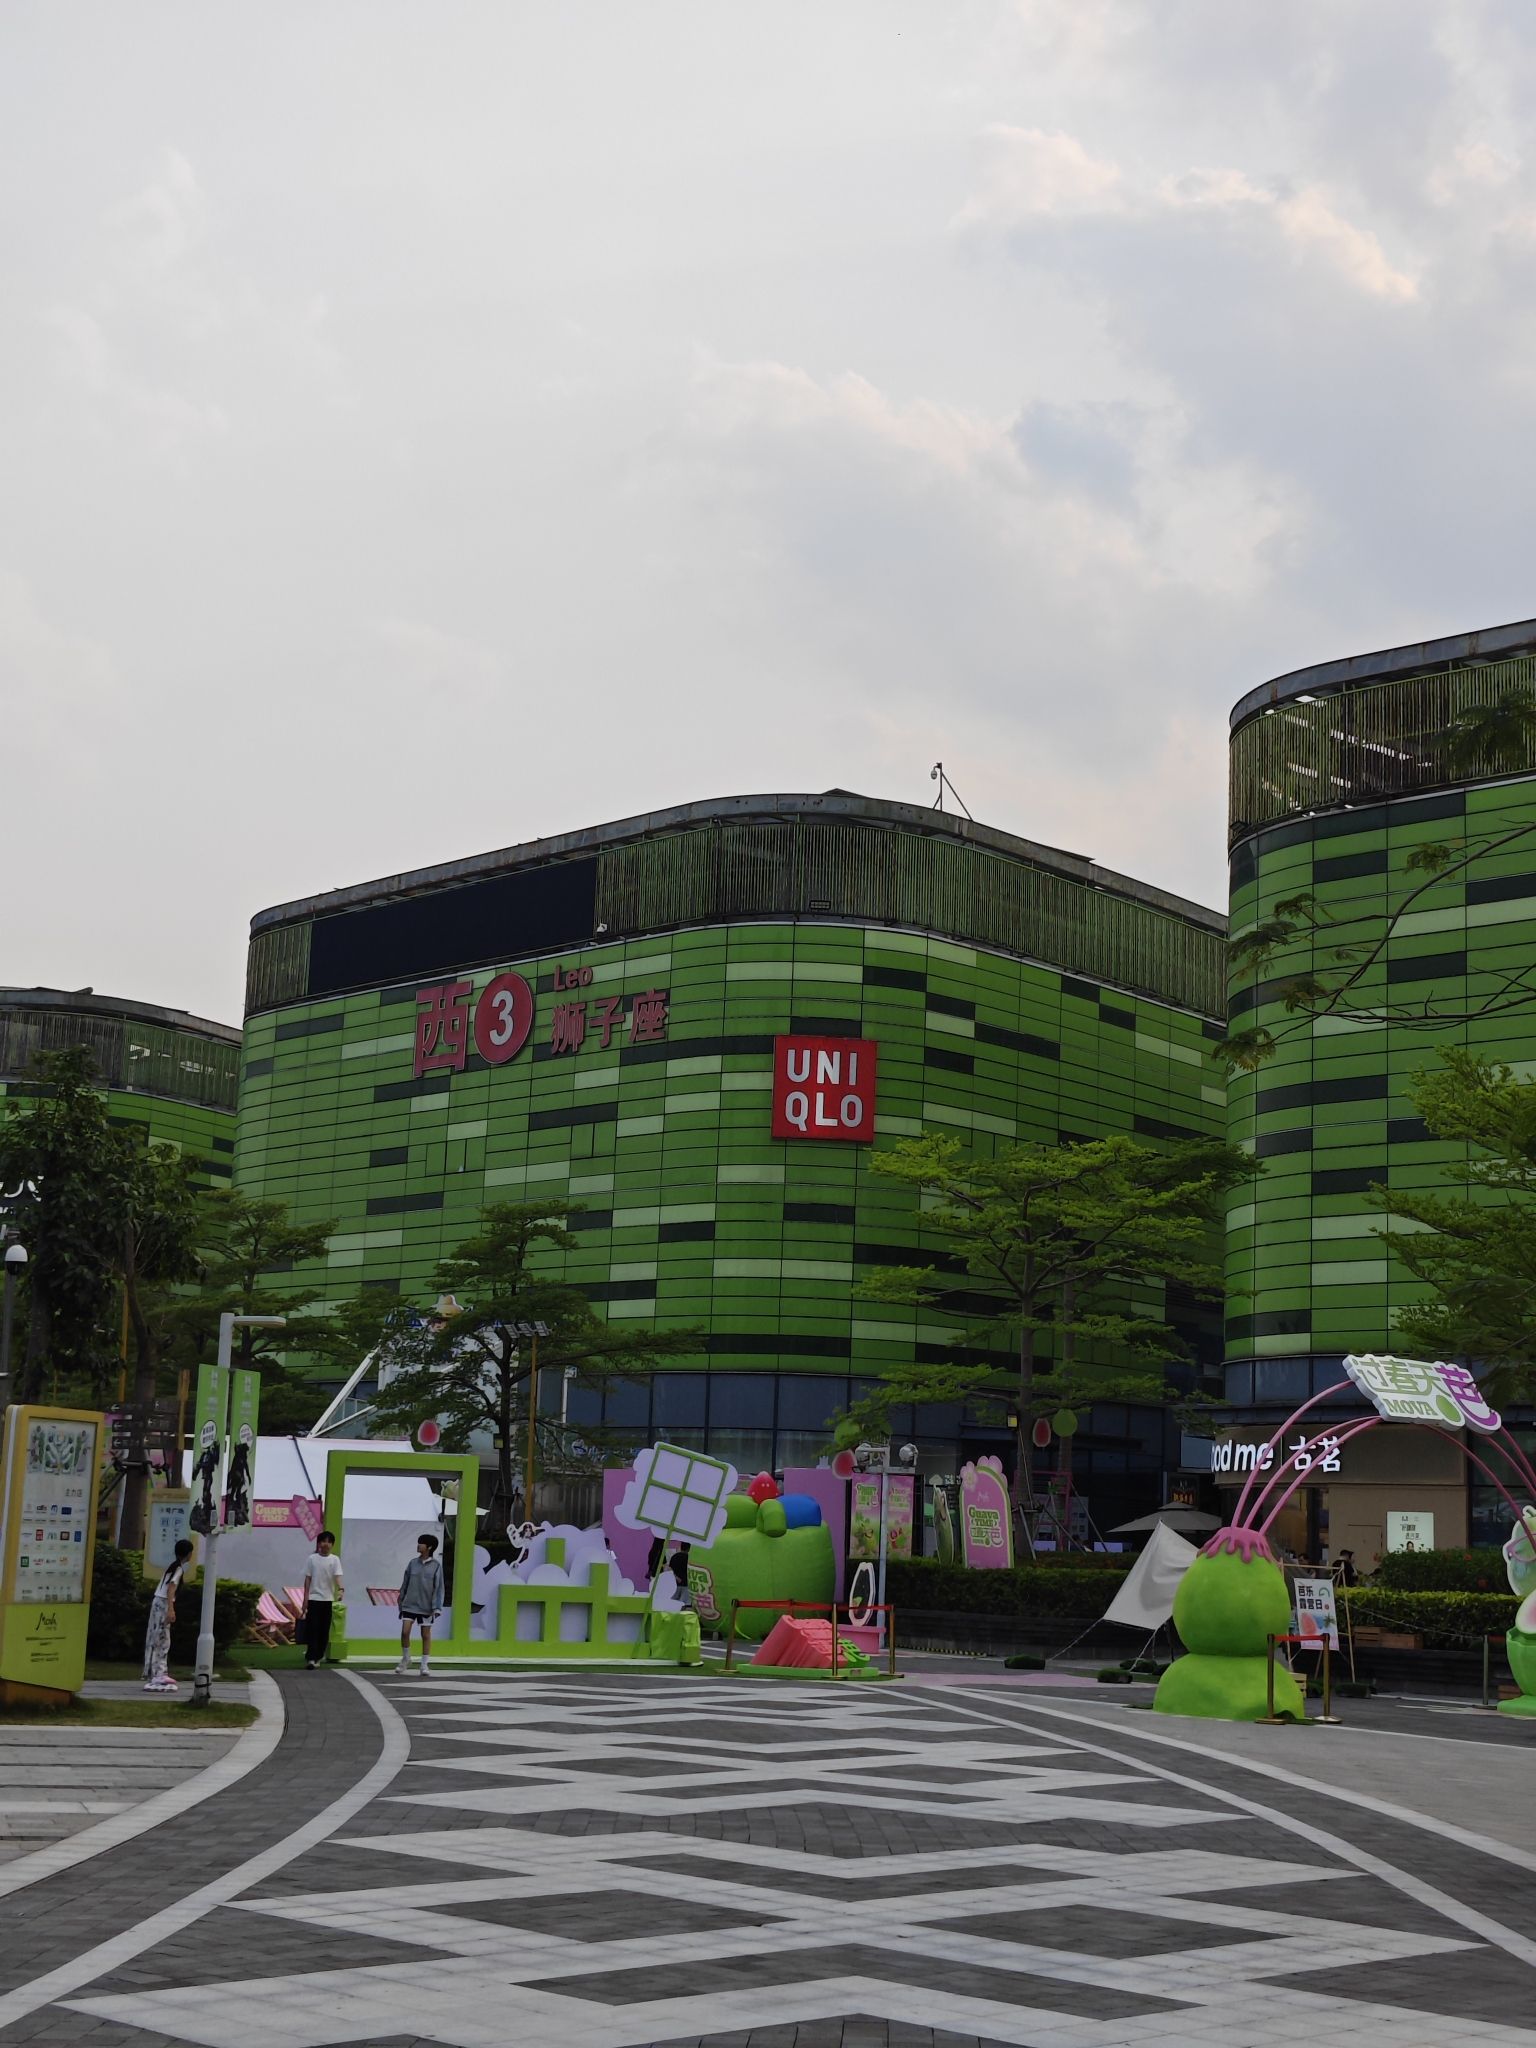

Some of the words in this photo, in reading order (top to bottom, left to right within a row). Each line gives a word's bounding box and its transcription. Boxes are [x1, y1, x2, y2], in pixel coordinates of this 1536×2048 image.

[554, 965, 593, 991] Leo
[414, 979, 473, 1077] 西
[550, 988, 668, 1054] 狮子座
[787, 1049, 857, 1086] UNI
[785, 1091, 863, 1132] QLO
[1383, 1397, 1438, 1416] MOVA
[1288, 1435, 1342, 1473] 古茗
[969, 1506, 999, 1519] Guava
